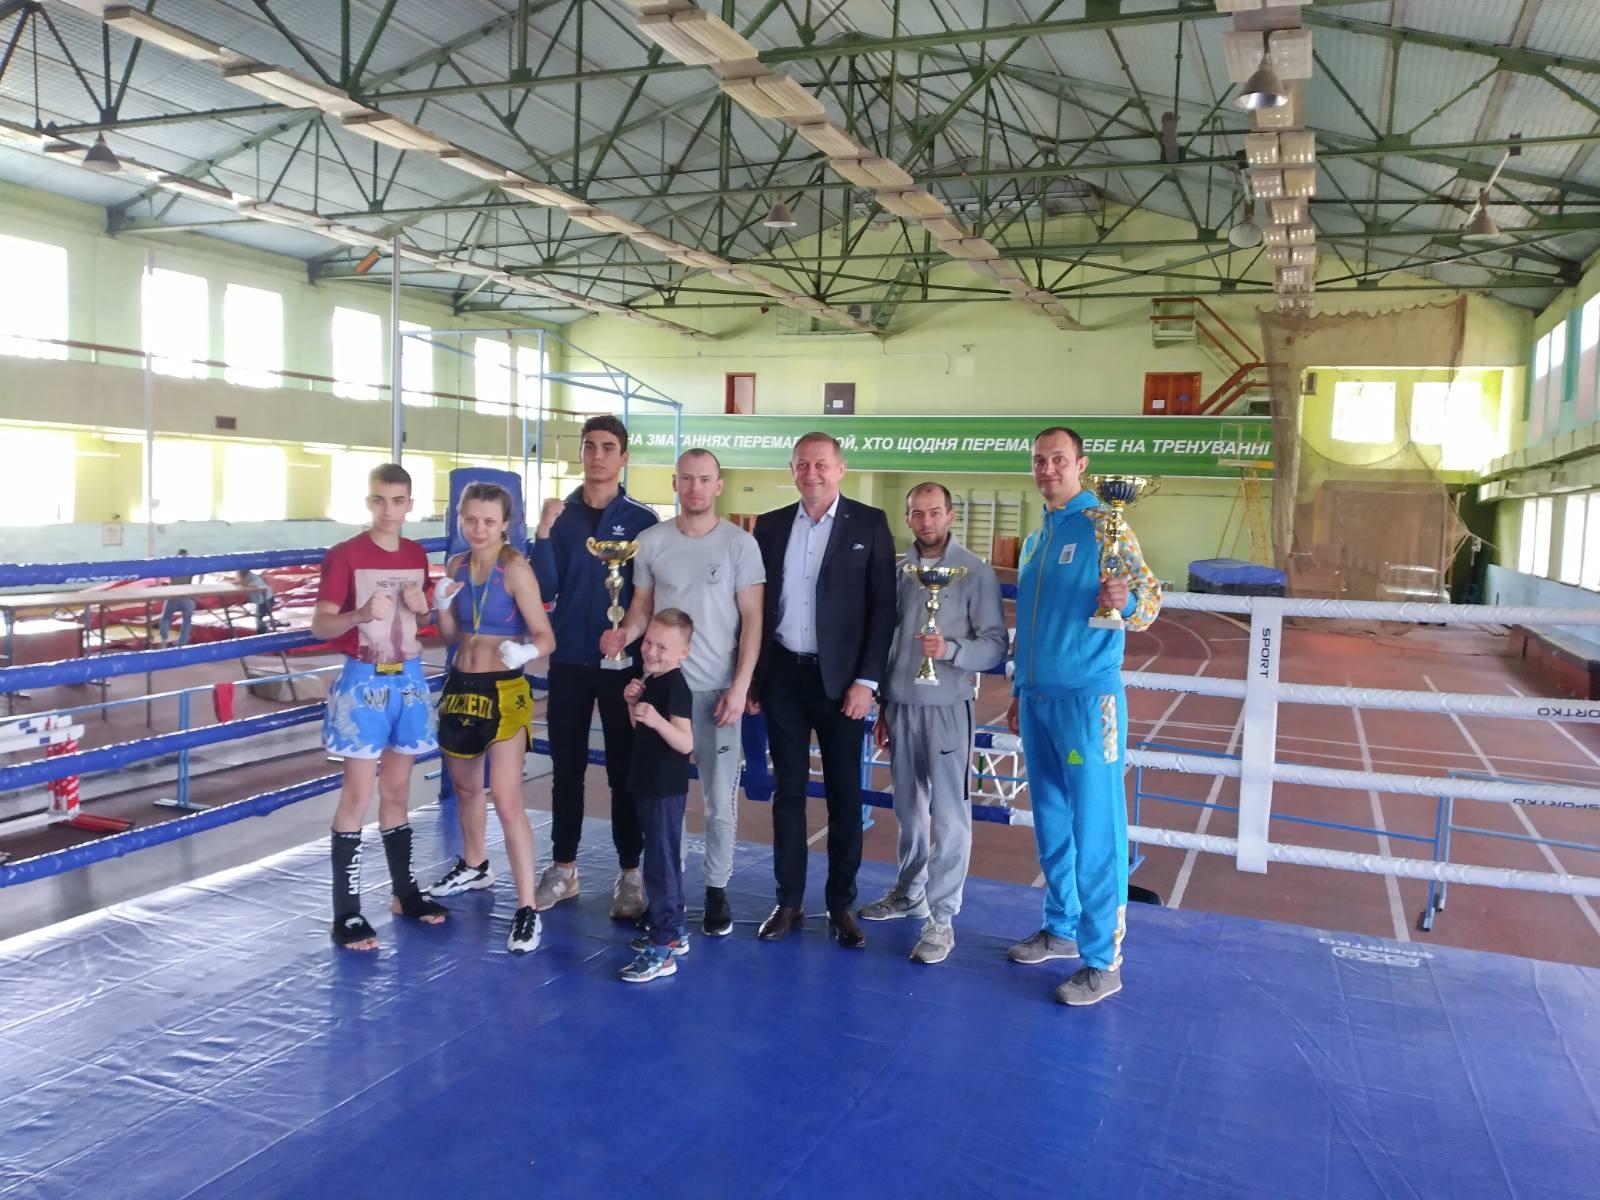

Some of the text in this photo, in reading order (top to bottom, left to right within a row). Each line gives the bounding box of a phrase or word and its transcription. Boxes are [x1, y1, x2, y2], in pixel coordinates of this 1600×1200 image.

[835, 434, 858, 452] ОЙ,
[861, 436, 894, 450] ХТО
[897, 437, 959, 453] ЩОДНЯ
[1082, 438, 1116, 453] ЕБЕ
[1120, 439, 1146, 453] НА
[1260, 627, 1272, 679] SPORT
